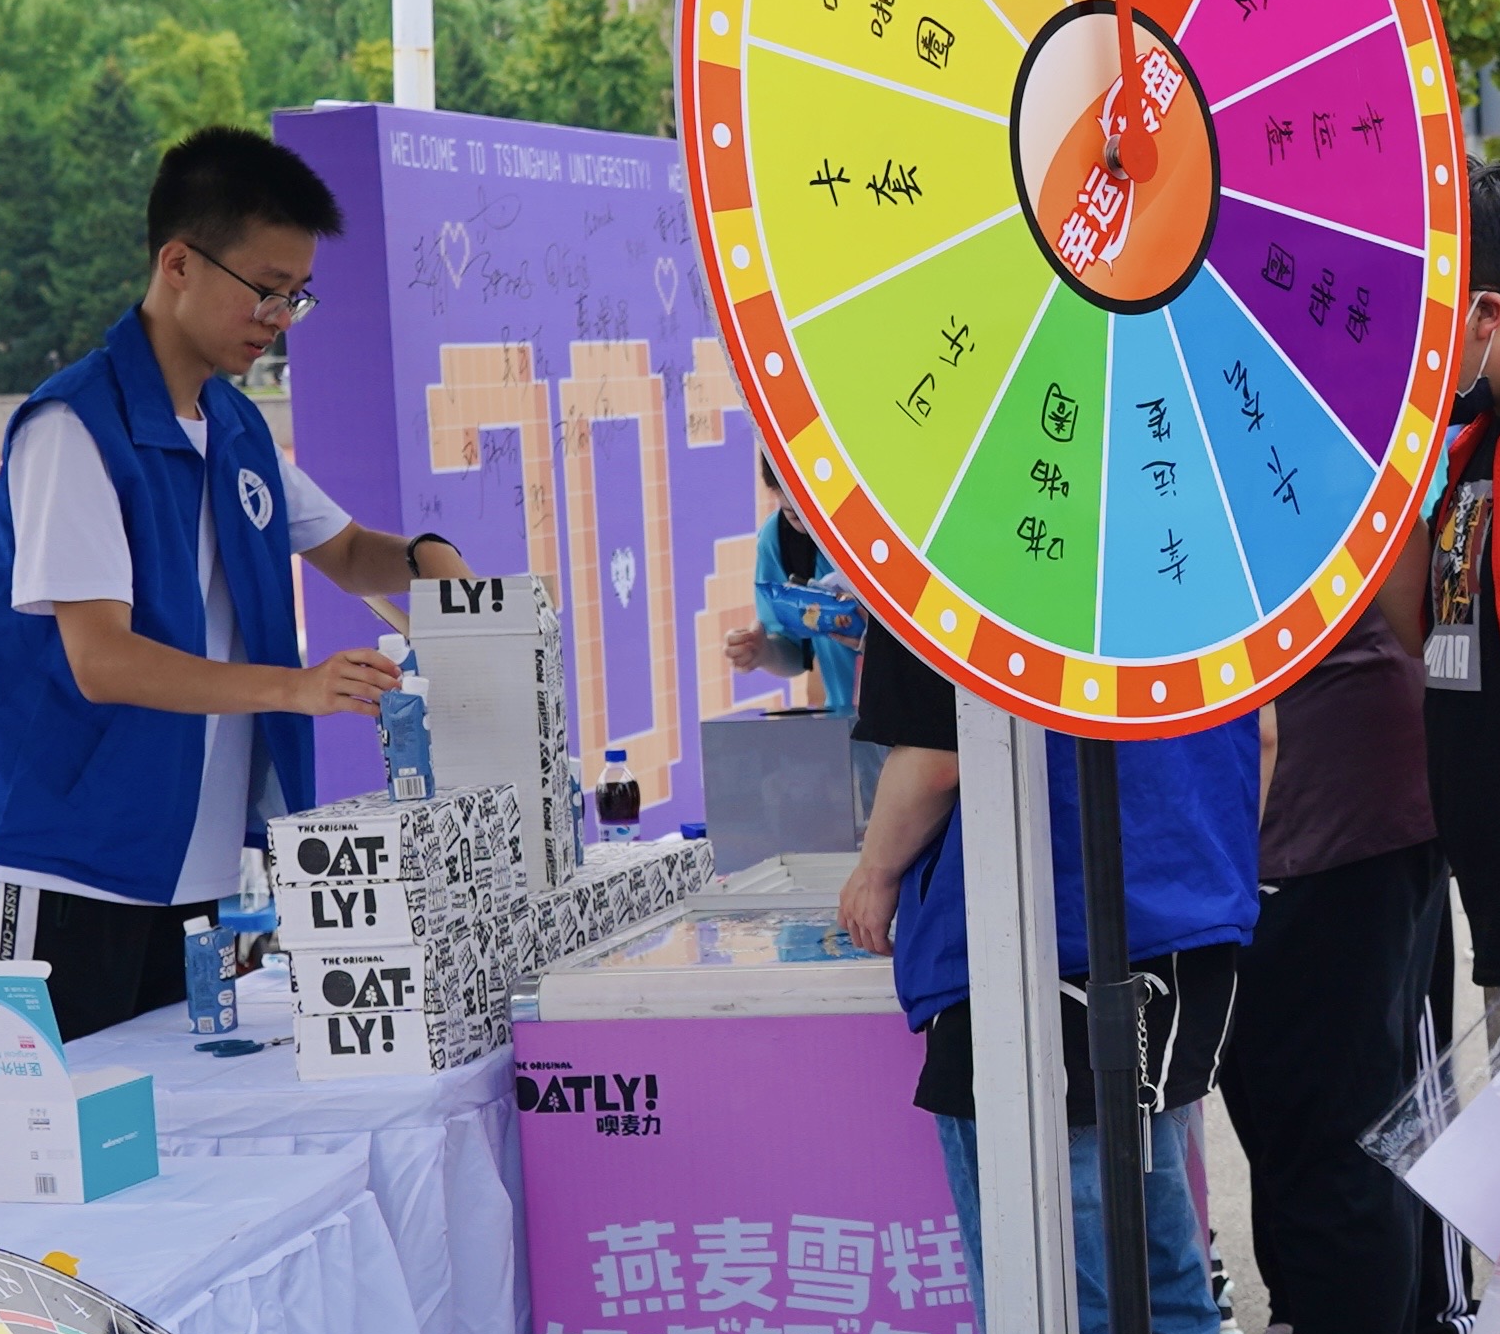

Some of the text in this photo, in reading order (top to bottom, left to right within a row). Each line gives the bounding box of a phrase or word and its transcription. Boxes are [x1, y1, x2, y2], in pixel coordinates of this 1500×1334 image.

[390, 131, 458, 172] WELCOME
[467, 140, 485, 175] TO
[494, 143, 561, 181] TSINGHUA
[569, 154, 651, 191] UNIVERSITY!
[1058, 50, 1183, 273] 幸运盘
[440, 579, 504, 614] LY!
[298, 823, 358, 834] THE ORIGINAL
[297, 836, 389, 877] OAT-
[311, 888, 377, 928] LY!
[322, 955, 384, 966] THE ORIGINAL
[322, 968, 415, 1009] OAT-
[328, 1015, 394, 1056] LY!
[530, 1061, 573, 1071] ORIGINAL
[516, 1074, 659, 1113] OATLY!
[589, 1213, 972, 1317] 燕麦雪糕
[66, 1297, 91, 1321] 4
